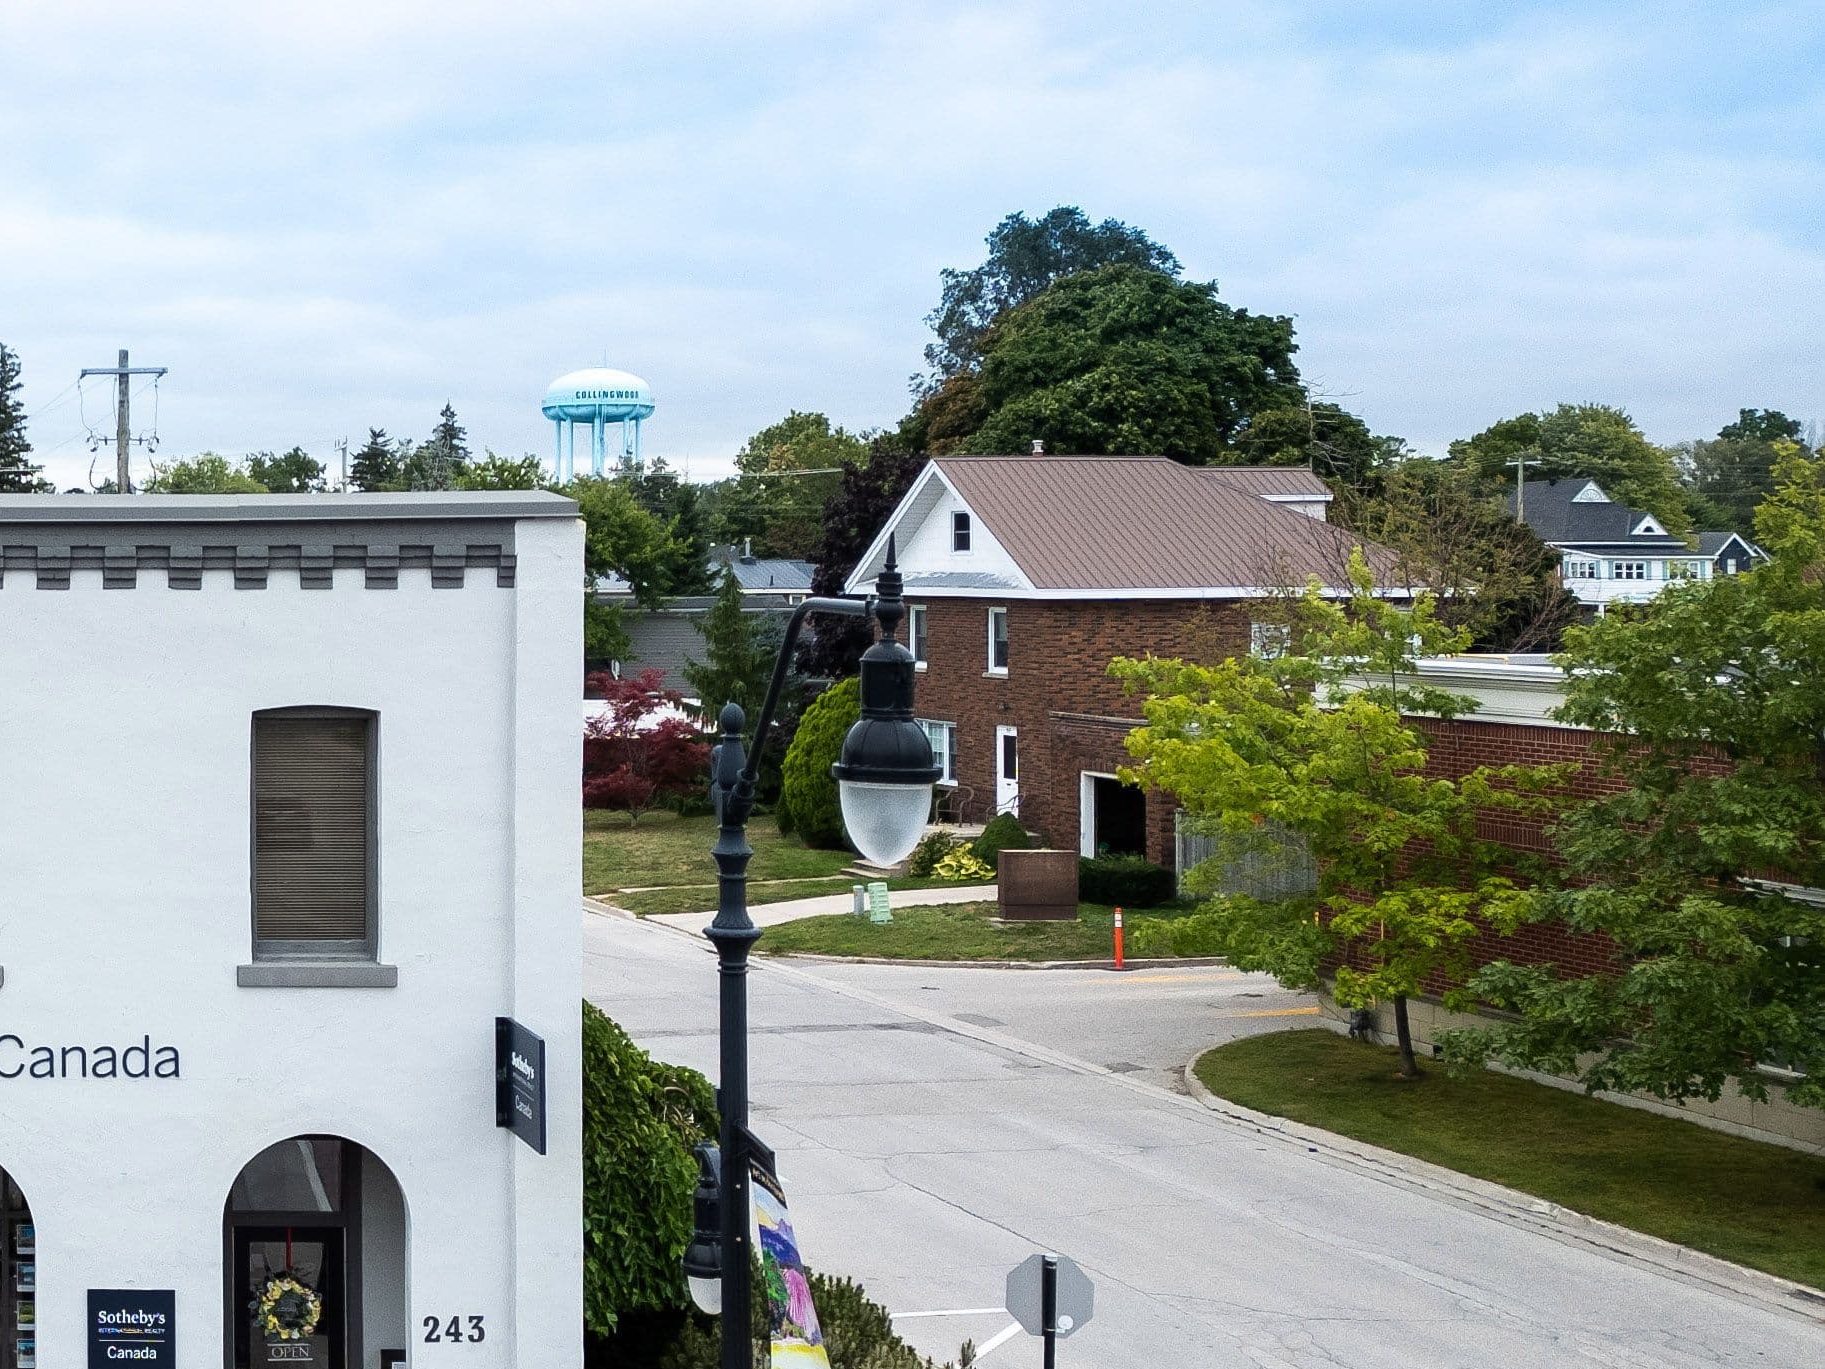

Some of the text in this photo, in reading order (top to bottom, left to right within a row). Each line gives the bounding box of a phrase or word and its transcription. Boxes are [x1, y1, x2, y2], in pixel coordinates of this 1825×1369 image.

[97, 1309, 166, 1327] Sotheby's
[423, 1315, 486, 1344] 243
[107, 1345, 157, 1360] Canada
[271, 1346, 310, 1358] OPEN
